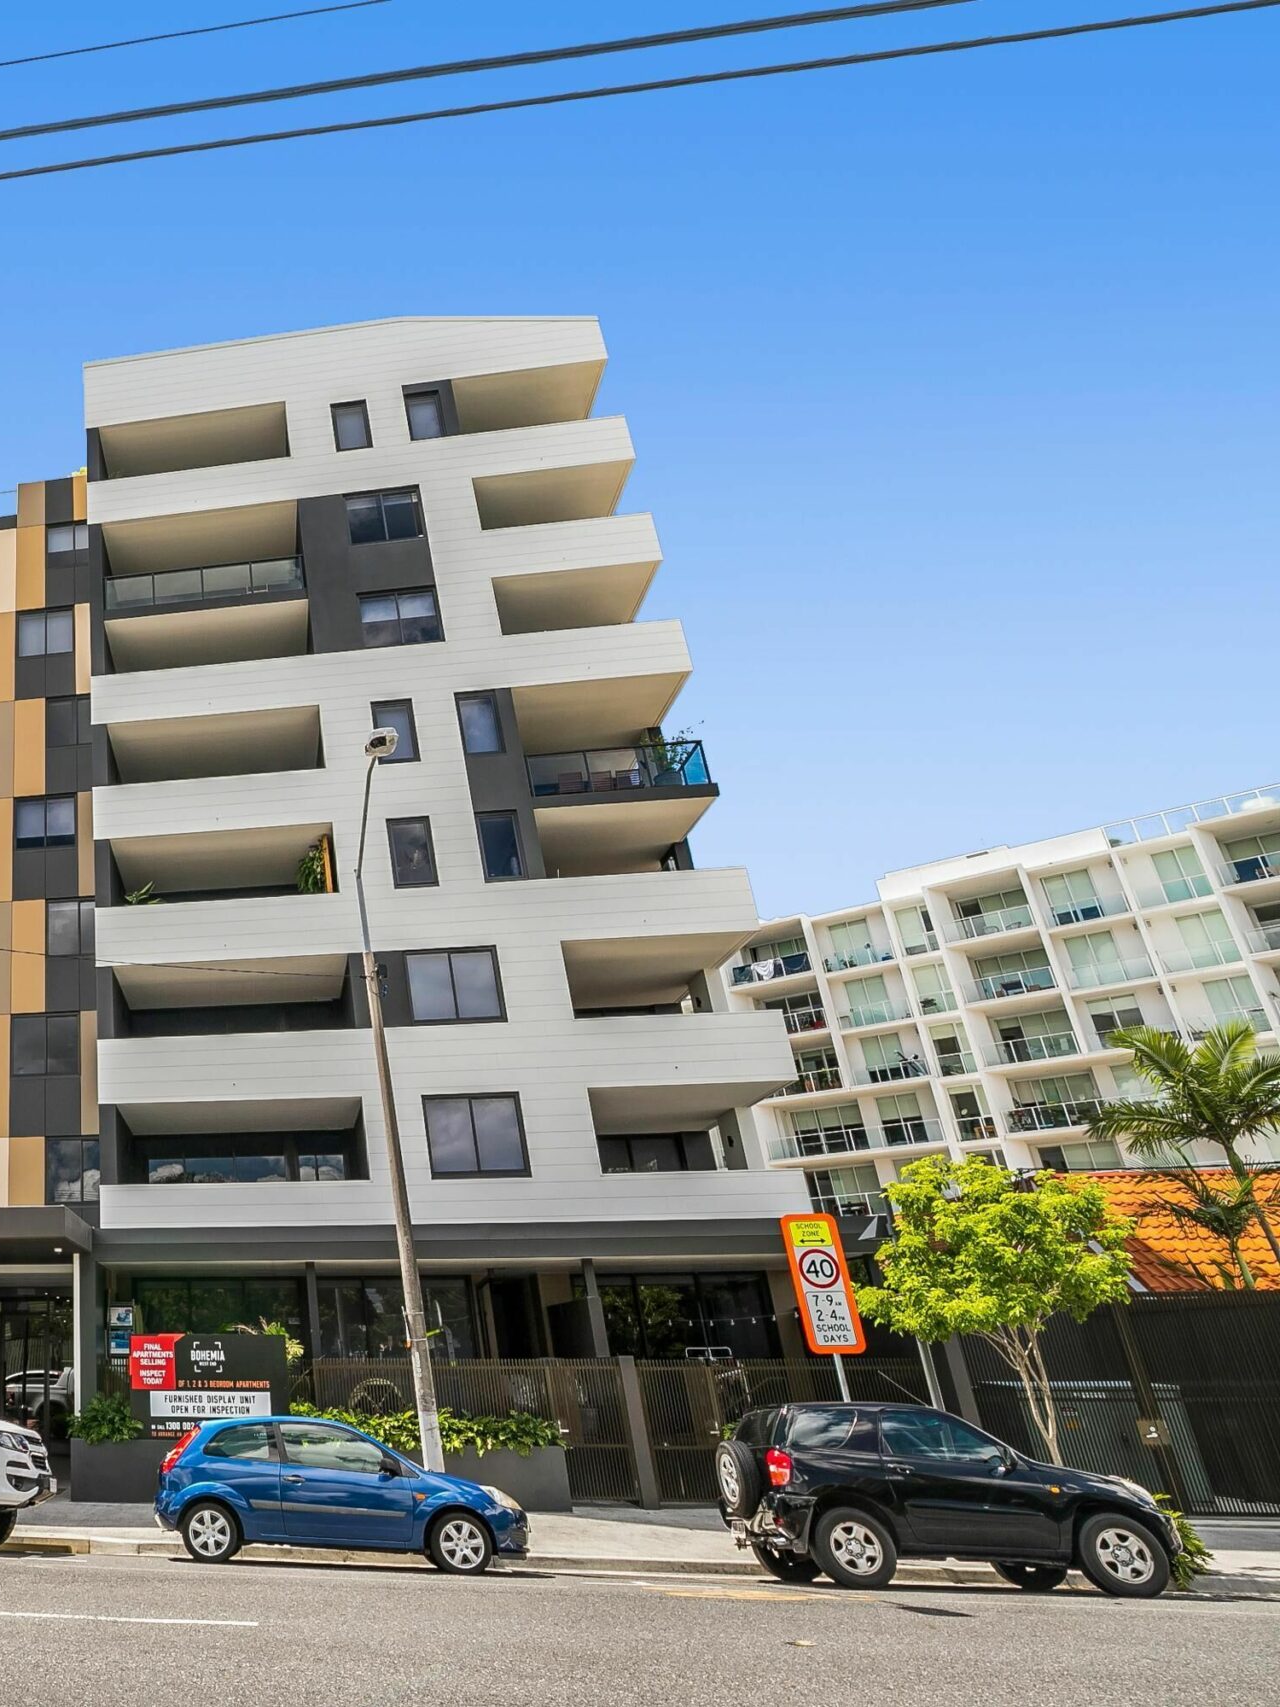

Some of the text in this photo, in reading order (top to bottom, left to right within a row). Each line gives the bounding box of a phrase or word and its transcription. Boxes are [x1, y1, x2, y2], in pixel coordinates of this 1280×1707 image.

[795, 1222, 822, 1230] SCHOOL
[806, 1258, 834, 1278] 40
[816, 1324, 851, 1332] SCHOOL
[823, 1334, 849, 1343] DAYS
[143, 1343, 162, 1351] FINAL
[132, 1350, 174, 1358] APARTMENTS
[190, 1349, 226, 1362] BOHEMIA
[140, 1358, 167, 1366] SELLING
[139, 1369, 166, 1377] INSPECT
[142, 1377, 163, 1385] TODAY
[209, 1380, 234, 1388] BEDROOM
[235, 1380, 270, 1389] APARTMENTS
[164, 1394, 256, 1404] FURNISHED DISPLAY UNIT
[171, 1404, 250, 1415] OPEN FOR INSPECTION
[165, 1421, 180, 1430] 1300
